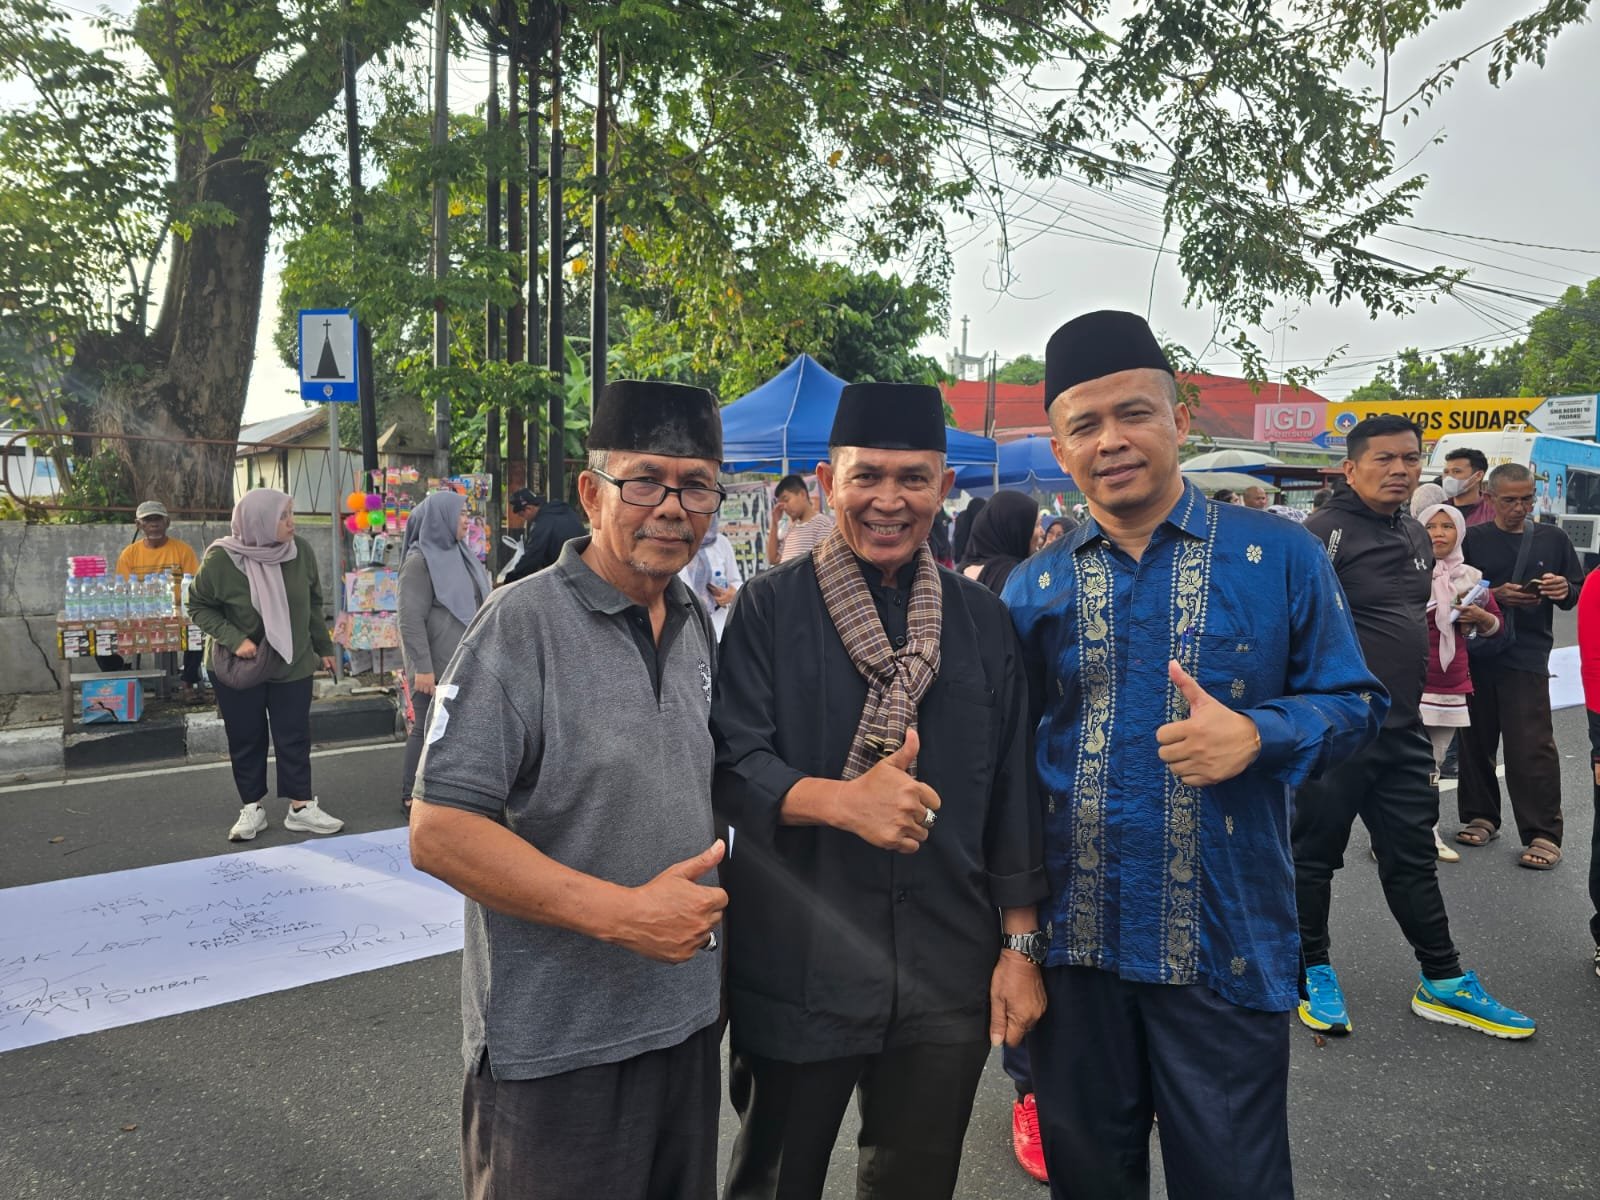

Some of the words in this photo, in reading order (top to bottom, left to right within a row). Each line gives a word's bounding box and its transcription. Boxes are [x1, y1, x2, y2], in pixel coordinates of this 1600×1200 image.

[1264, 407, 1316, 431] IGD
[1448, 410, 1531, 430] SUDARS
[0, 982, 108, 1011] WARDI
